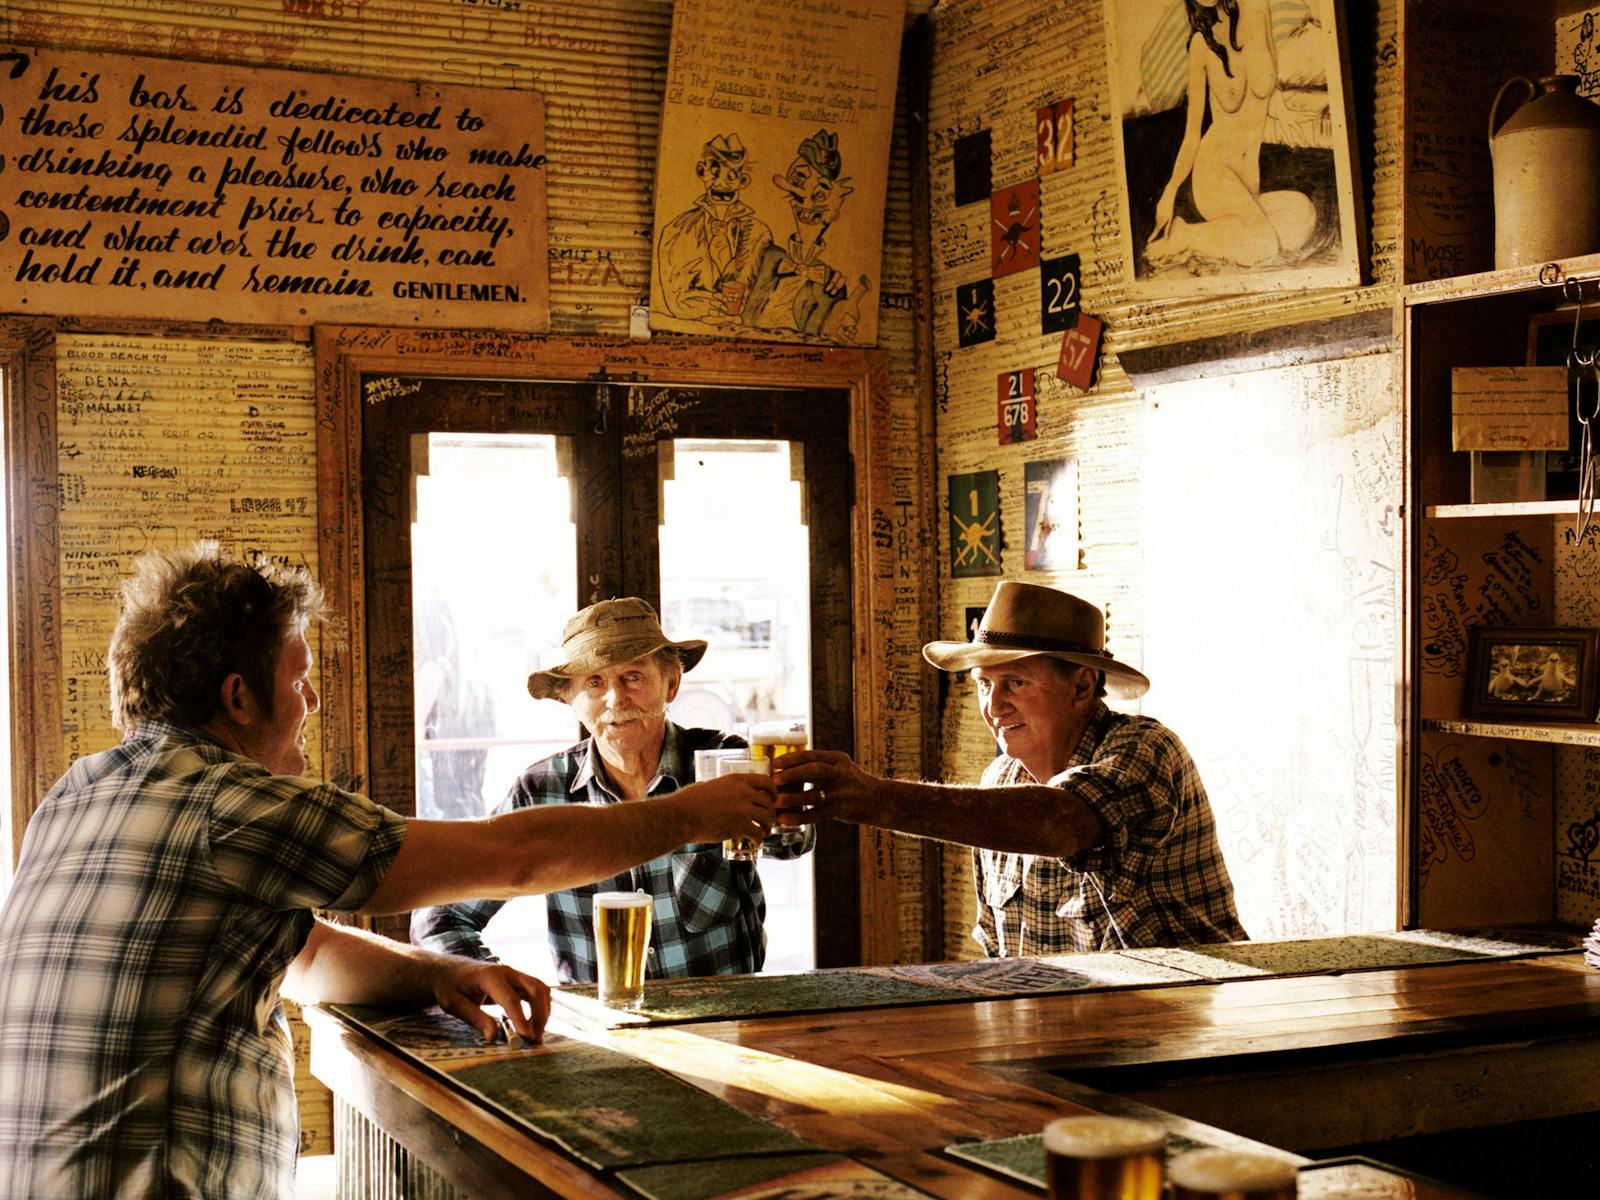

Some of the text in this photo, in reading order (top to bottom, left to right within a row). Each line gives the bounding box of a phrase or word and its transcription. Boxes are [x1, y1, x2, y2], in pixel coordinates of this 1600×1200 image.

[129, 74, 198, 112] bar
[211, 86, 245, 115] is
[269, 90, 441, 131] dedicated
[455, 107, 485, 132] to
[20, 103, 104, 139] those
[117, 114, 267, 155] splendid
[277, 126, 382, 166] fellows
[395, 135, 449, 162] who
[468, 143, 549, 171] make
[1039, 113, 1073, 166] 32
[17, 147, 517, 202] drinking a pleasure, who reach
[14, 184, 515, 249] contentment prior to capacity,
[18, 220, 93, 250] and
[103, 220, 181, 253] what
[266, 226, 317, 262] the
[331, 234, 430, 268] drink,
[437, 248, 496, 267] can
[1411, 237, 1465, 265] MOOSE
[15, 249, 103, 285] hold
[152, 263, 226, 291] and
[241, 264, 373, 298] remain
[393, 281, 527, 303] GENTLEMEN.
[1048, 272, 1076, 314] 22
[67, 350, 104, 359] BLOOD
[110, 351, 149, 361] BEACH
[364, 377, 401, 395] JAMES
[1008, 373, 1023, 396] 21
[1003, 403, 1029, 427] 678
[969, 490, 979, 516] 1
